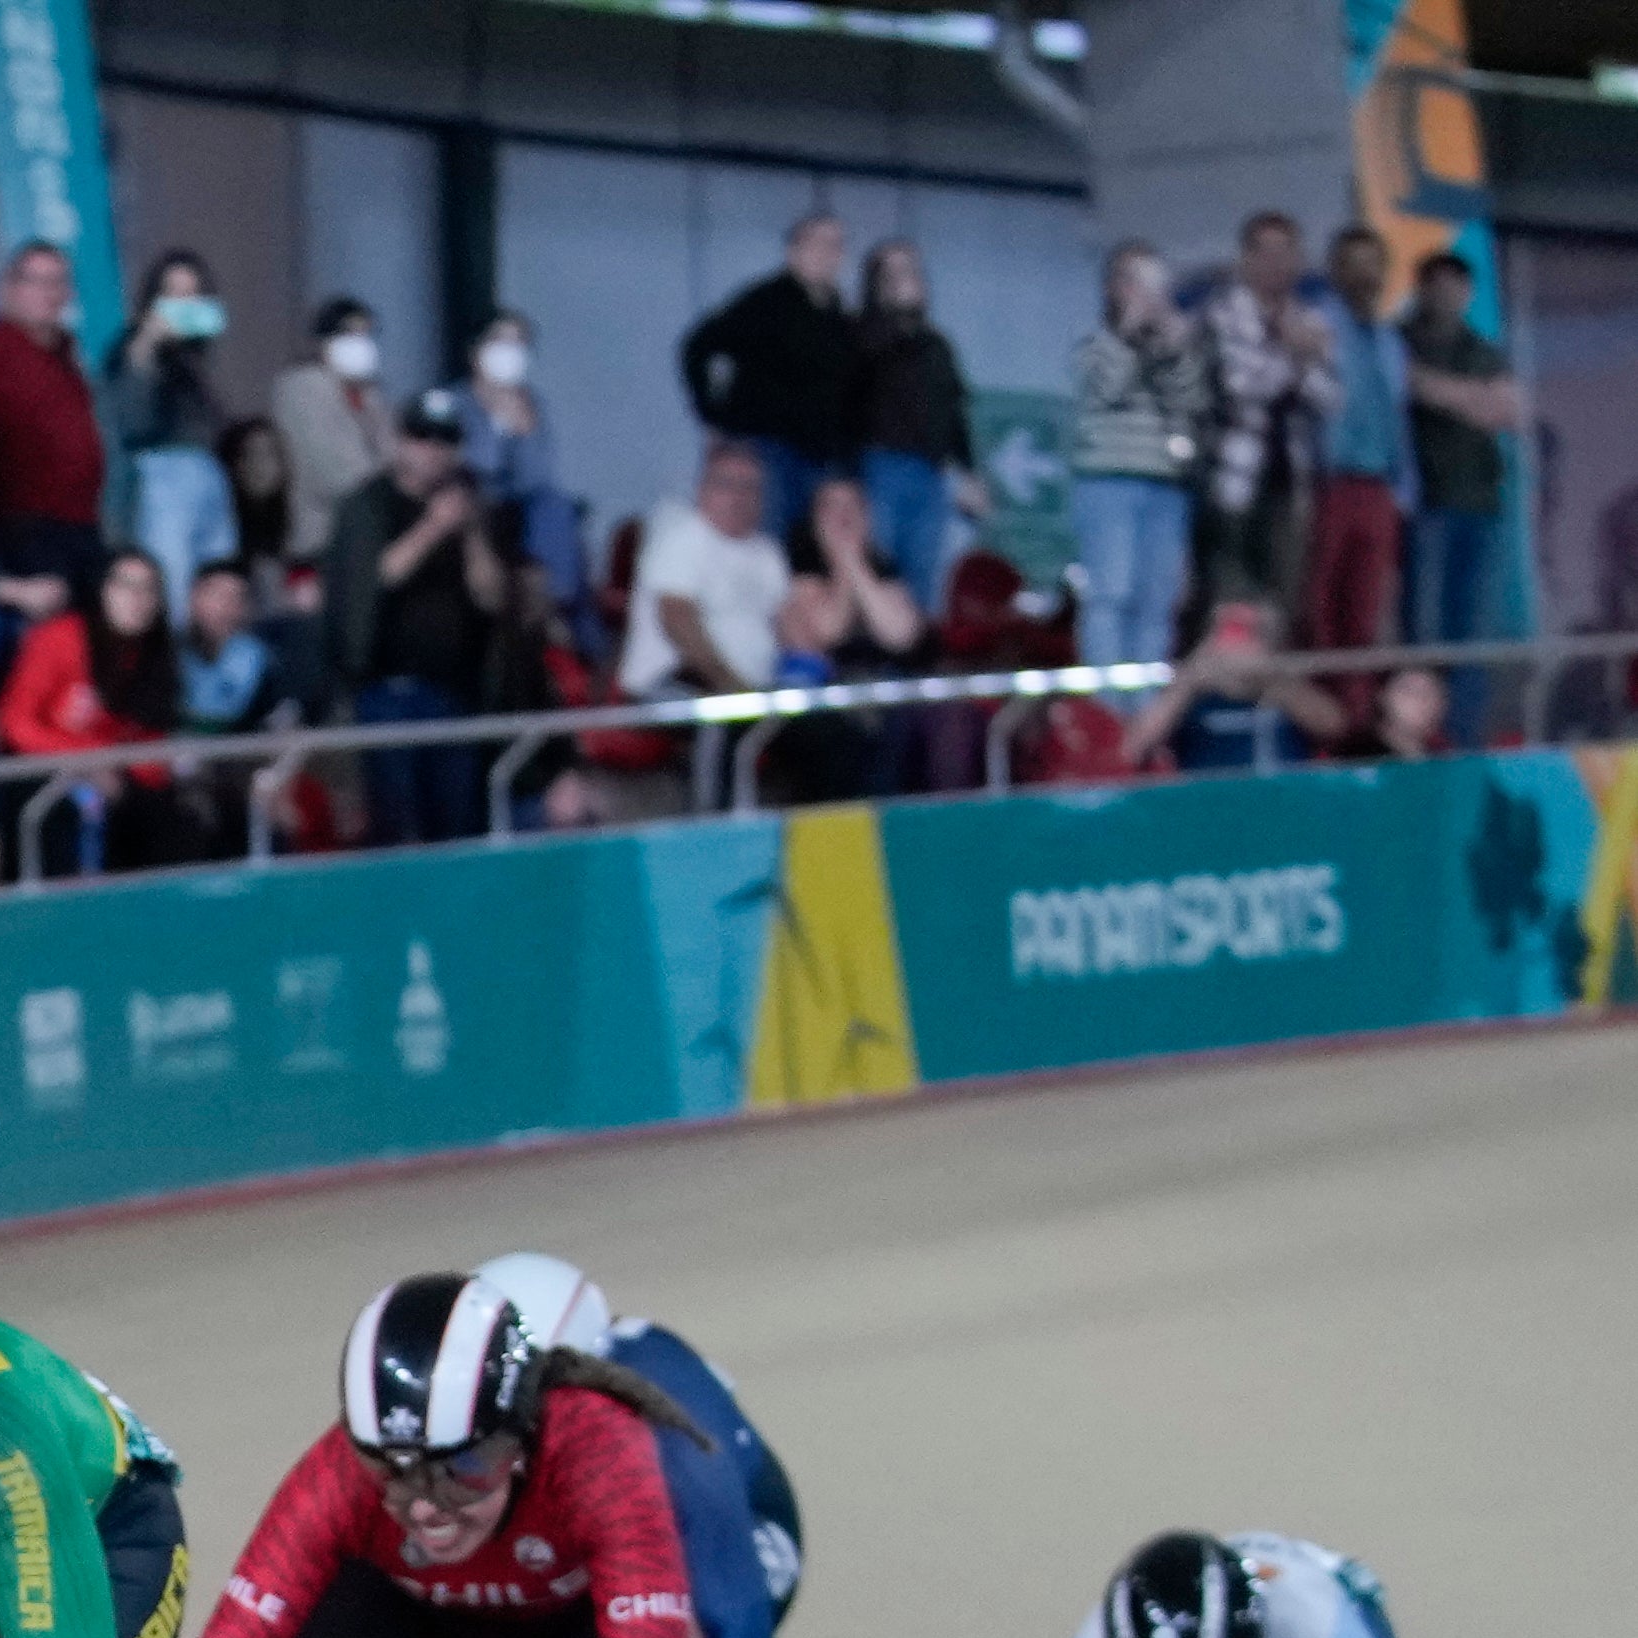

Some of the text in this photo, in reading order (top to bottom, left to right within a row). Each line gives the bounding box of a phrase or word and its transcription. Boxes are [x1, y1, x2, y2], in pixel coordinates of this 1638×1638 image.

[1008, 862, 1345, 980] PANAMSPORTS
[395, 1565, 591, 1611] HILE
[606, 1592, 691, 1623] CHIL
